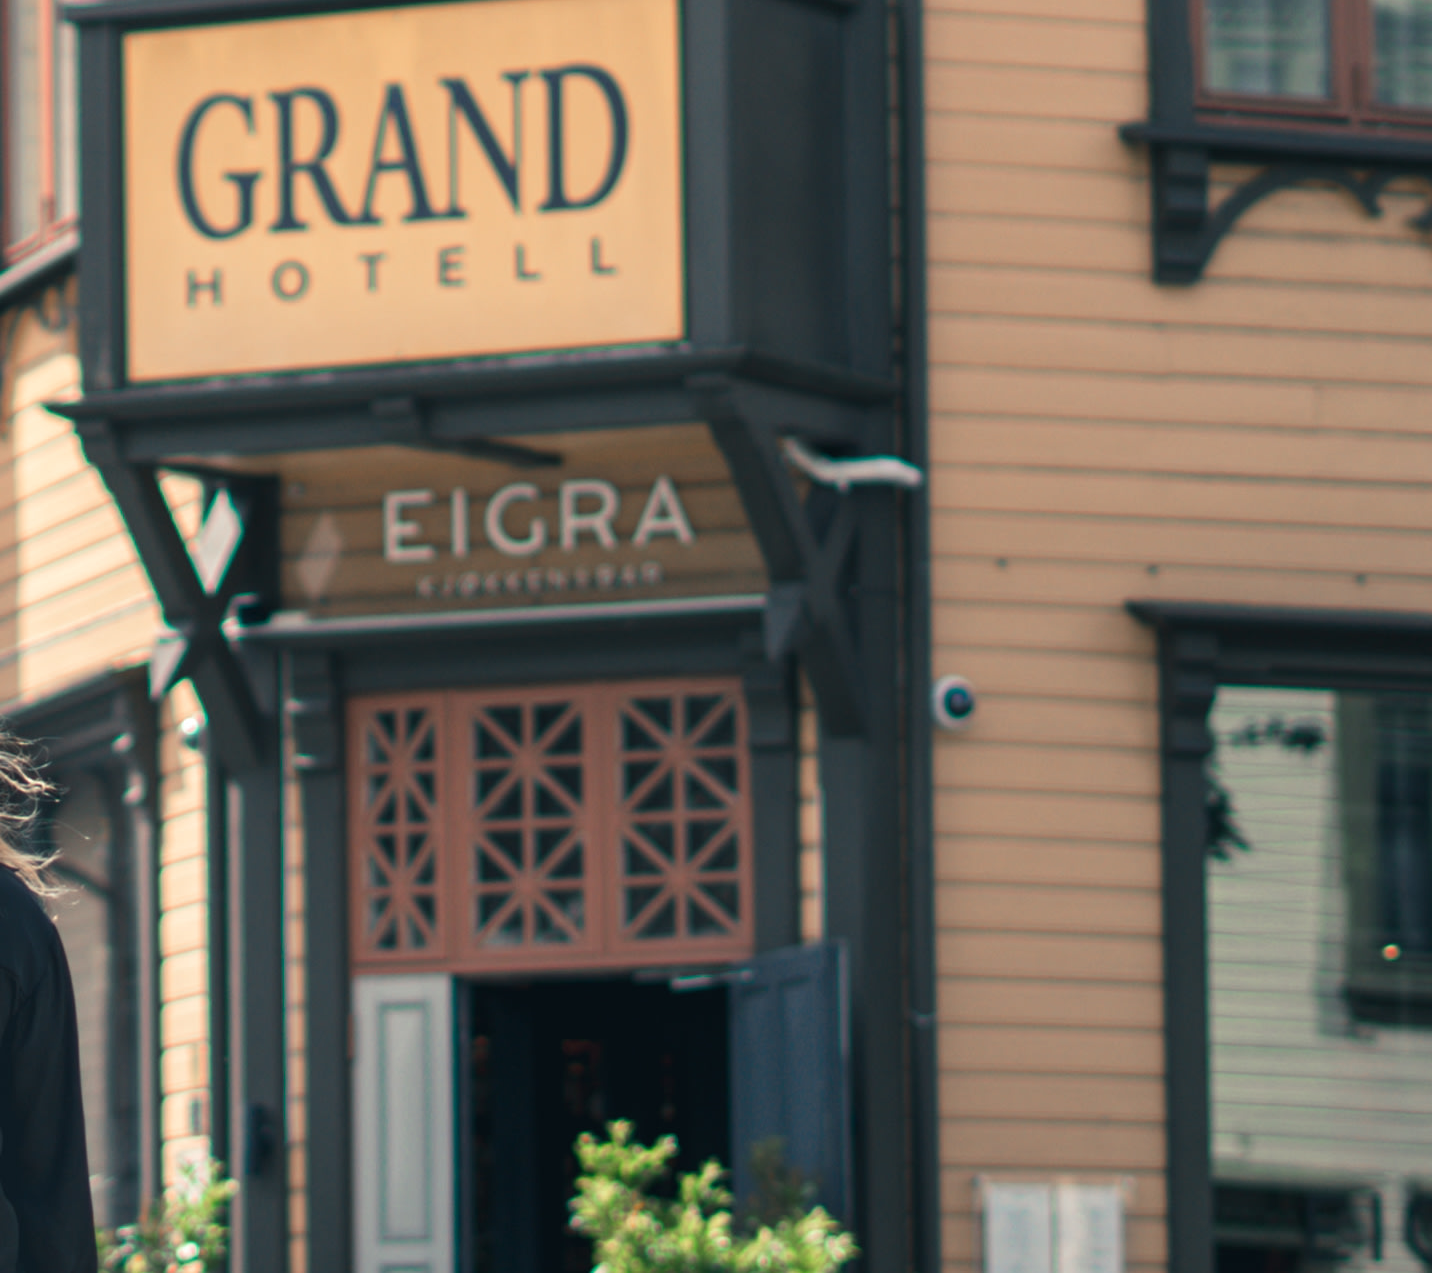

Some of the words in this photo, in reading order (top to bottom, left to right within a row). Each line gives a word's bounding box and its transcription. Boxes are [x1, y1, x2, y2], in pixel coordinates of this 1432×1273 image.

[175, 62, 630, 242] GRAND
[186, 236, 617, 309] HOTELL
[384, 475, 694, 561] EIGRA
